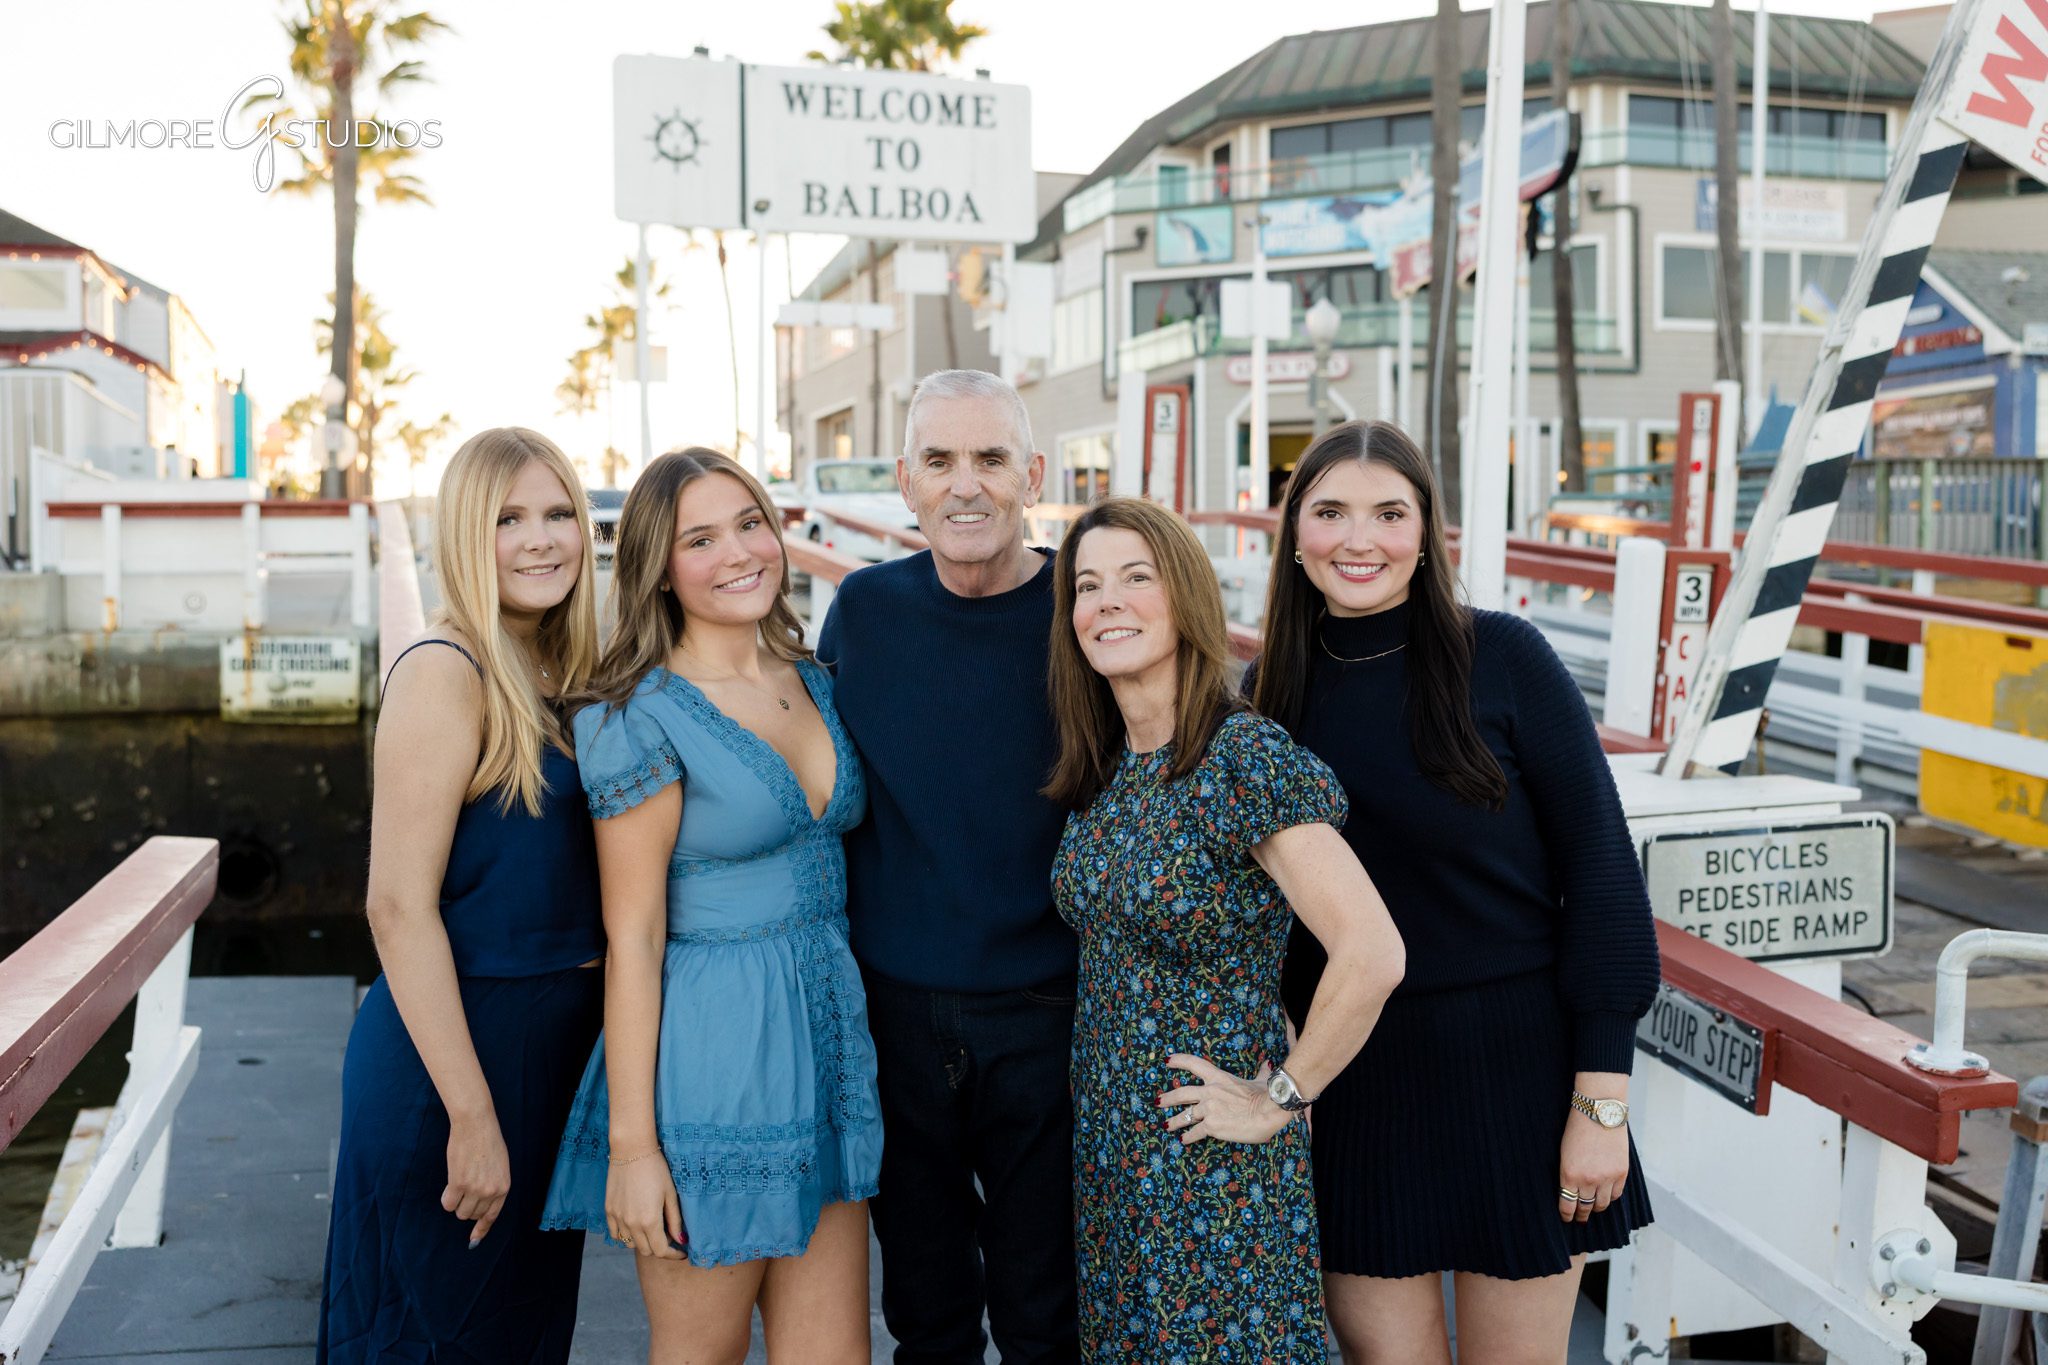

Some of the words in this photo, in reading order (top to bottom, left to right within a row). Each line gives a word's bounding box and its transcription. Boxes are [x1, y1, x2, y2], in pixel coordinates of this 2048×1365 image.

[1965, 0, 2048, 129] W
[782, 81, 997, 130] WELCOME
[865, 136, 921, 172] TO
[802, 181, 983, 224] BALBOA
[1160, 403, 1172, 420] 3
[1684, 576, 1702, 603] 3
[1705, 842, 1829, 876] BICYCLES
[1679, 876, 1854, 914] PEDESTRIANS
[1724, 918, 1781, 947] SIDE
[1793, 910, 1869, 941] RAMP
[1651, 998, 1699, 1058] YOUR
[1703, 1024, 1753, 1084] STEP
